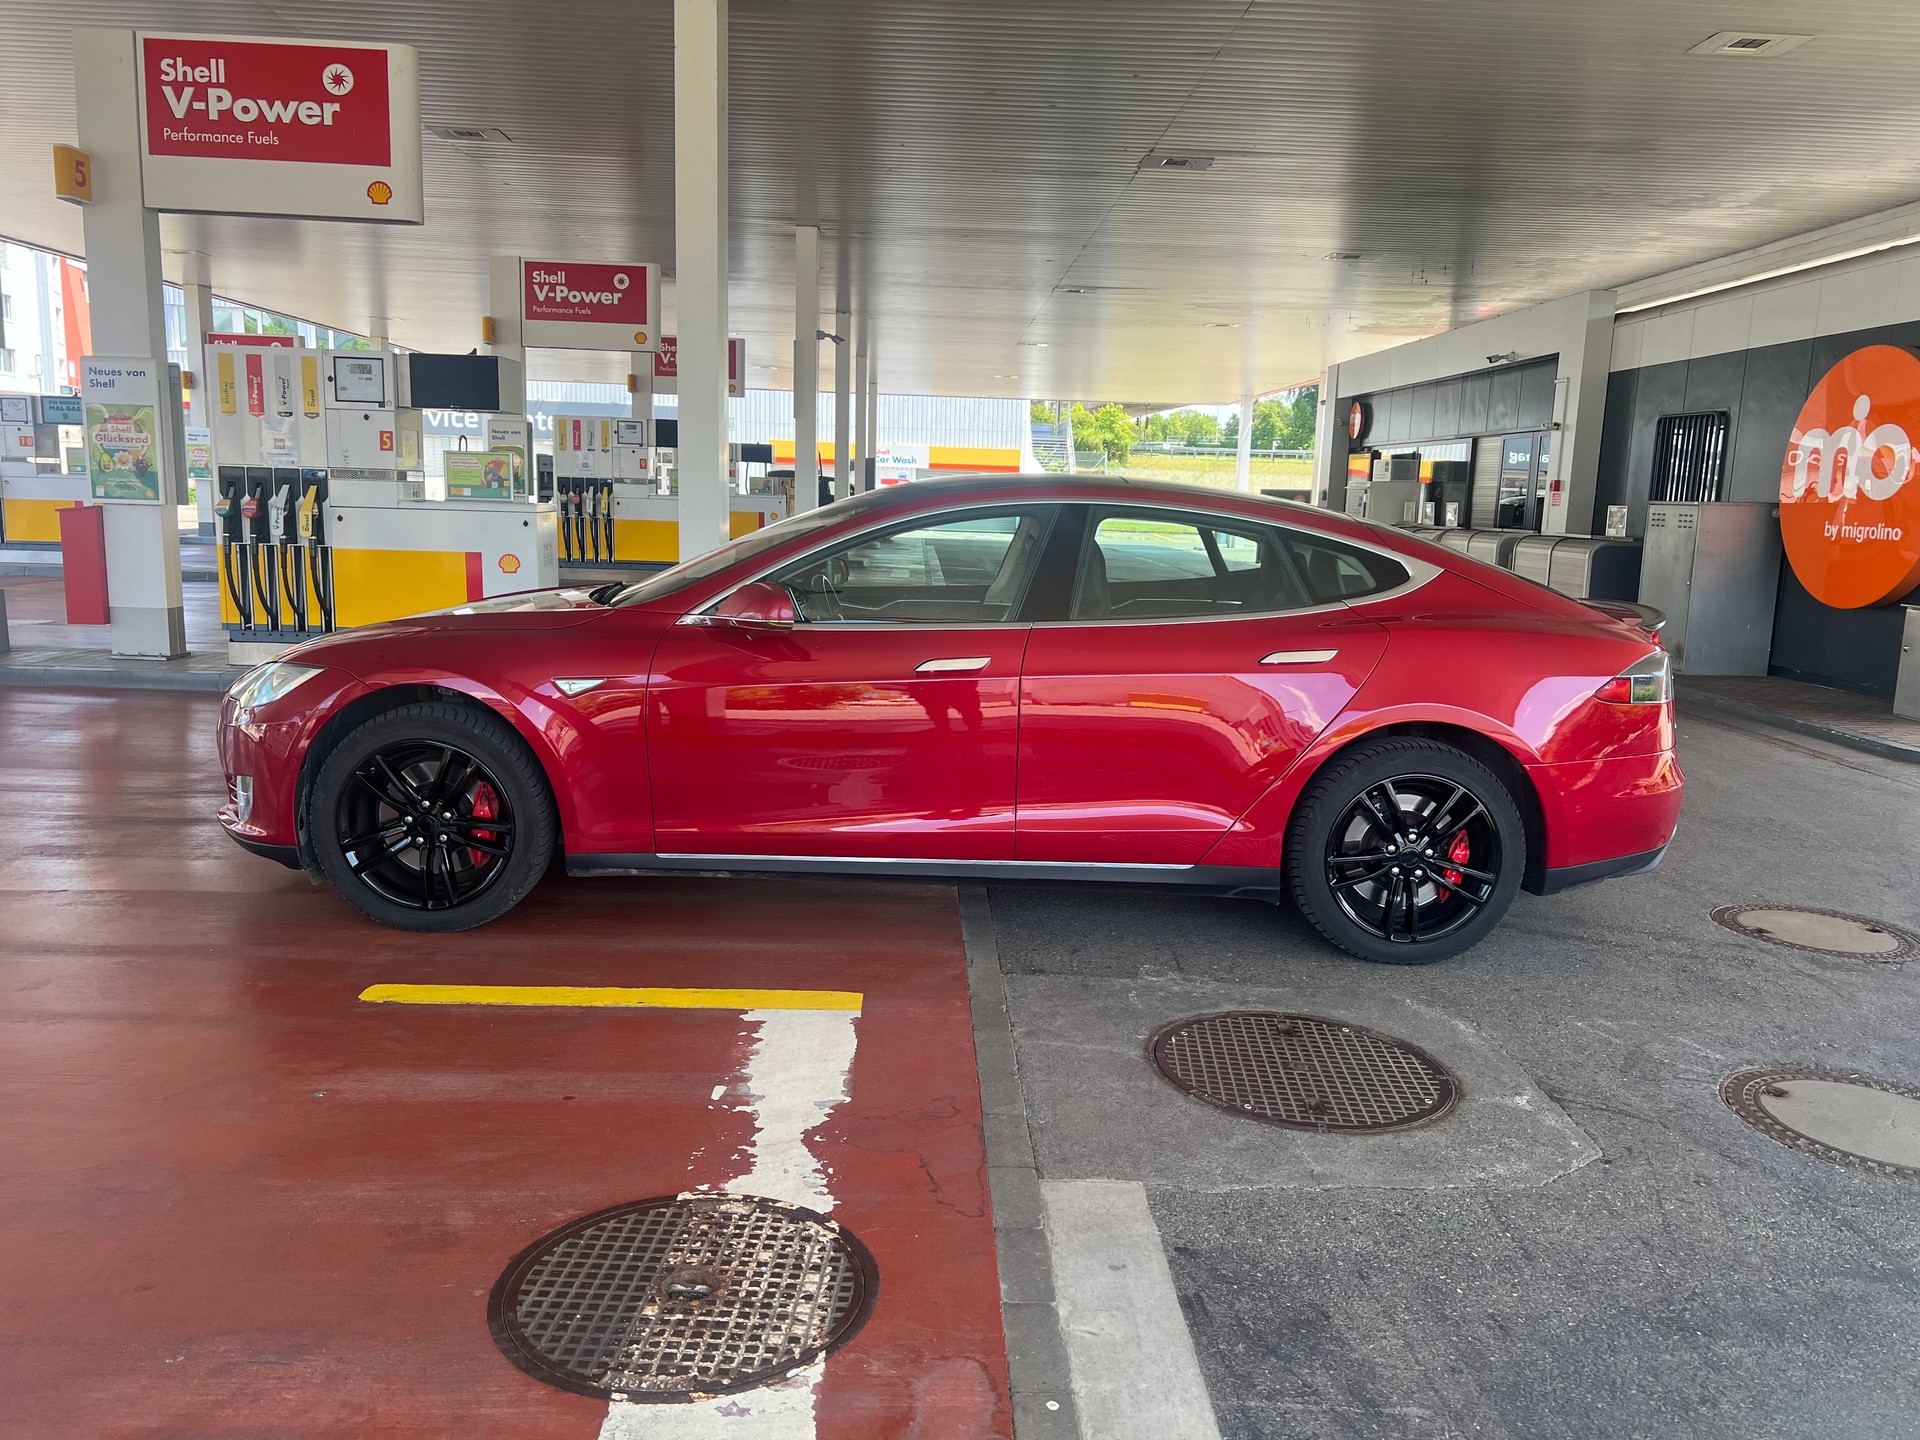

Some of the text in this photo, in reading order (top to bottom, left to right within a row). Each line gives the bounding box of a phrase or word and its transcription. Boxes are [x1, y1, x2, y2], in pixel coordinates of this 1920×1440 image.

[160, 57, 225, 83] Shell
[160, 85, 341, 126] V-Power
[163, 127, 279, 146] Performance Fuels
[74, 160, 87, 188] 5
[532, 270, 566, 284] Shell
[533, 284, 623, 305] V-Power
[532, 305, 592, 315] Performance Fuels
[661, 343, 677, 352] She
[88, 366, 146, 378] Neues von
[89, 379, 115, 389] Shell
[423, 410, 479, 428] vice
[110, 425, 132, 434] Shell
[21, 437, 33, 445] 10
[95, 433, 149, 444] Glücksrad
[382, 432, 391, 449] 5
[1793, 394, 1912, 501] mio
[640, 460, 646, 469] 9
[892, 456, 917, 464] Wash
[1824, 520, 1902, 543] by migrolino
